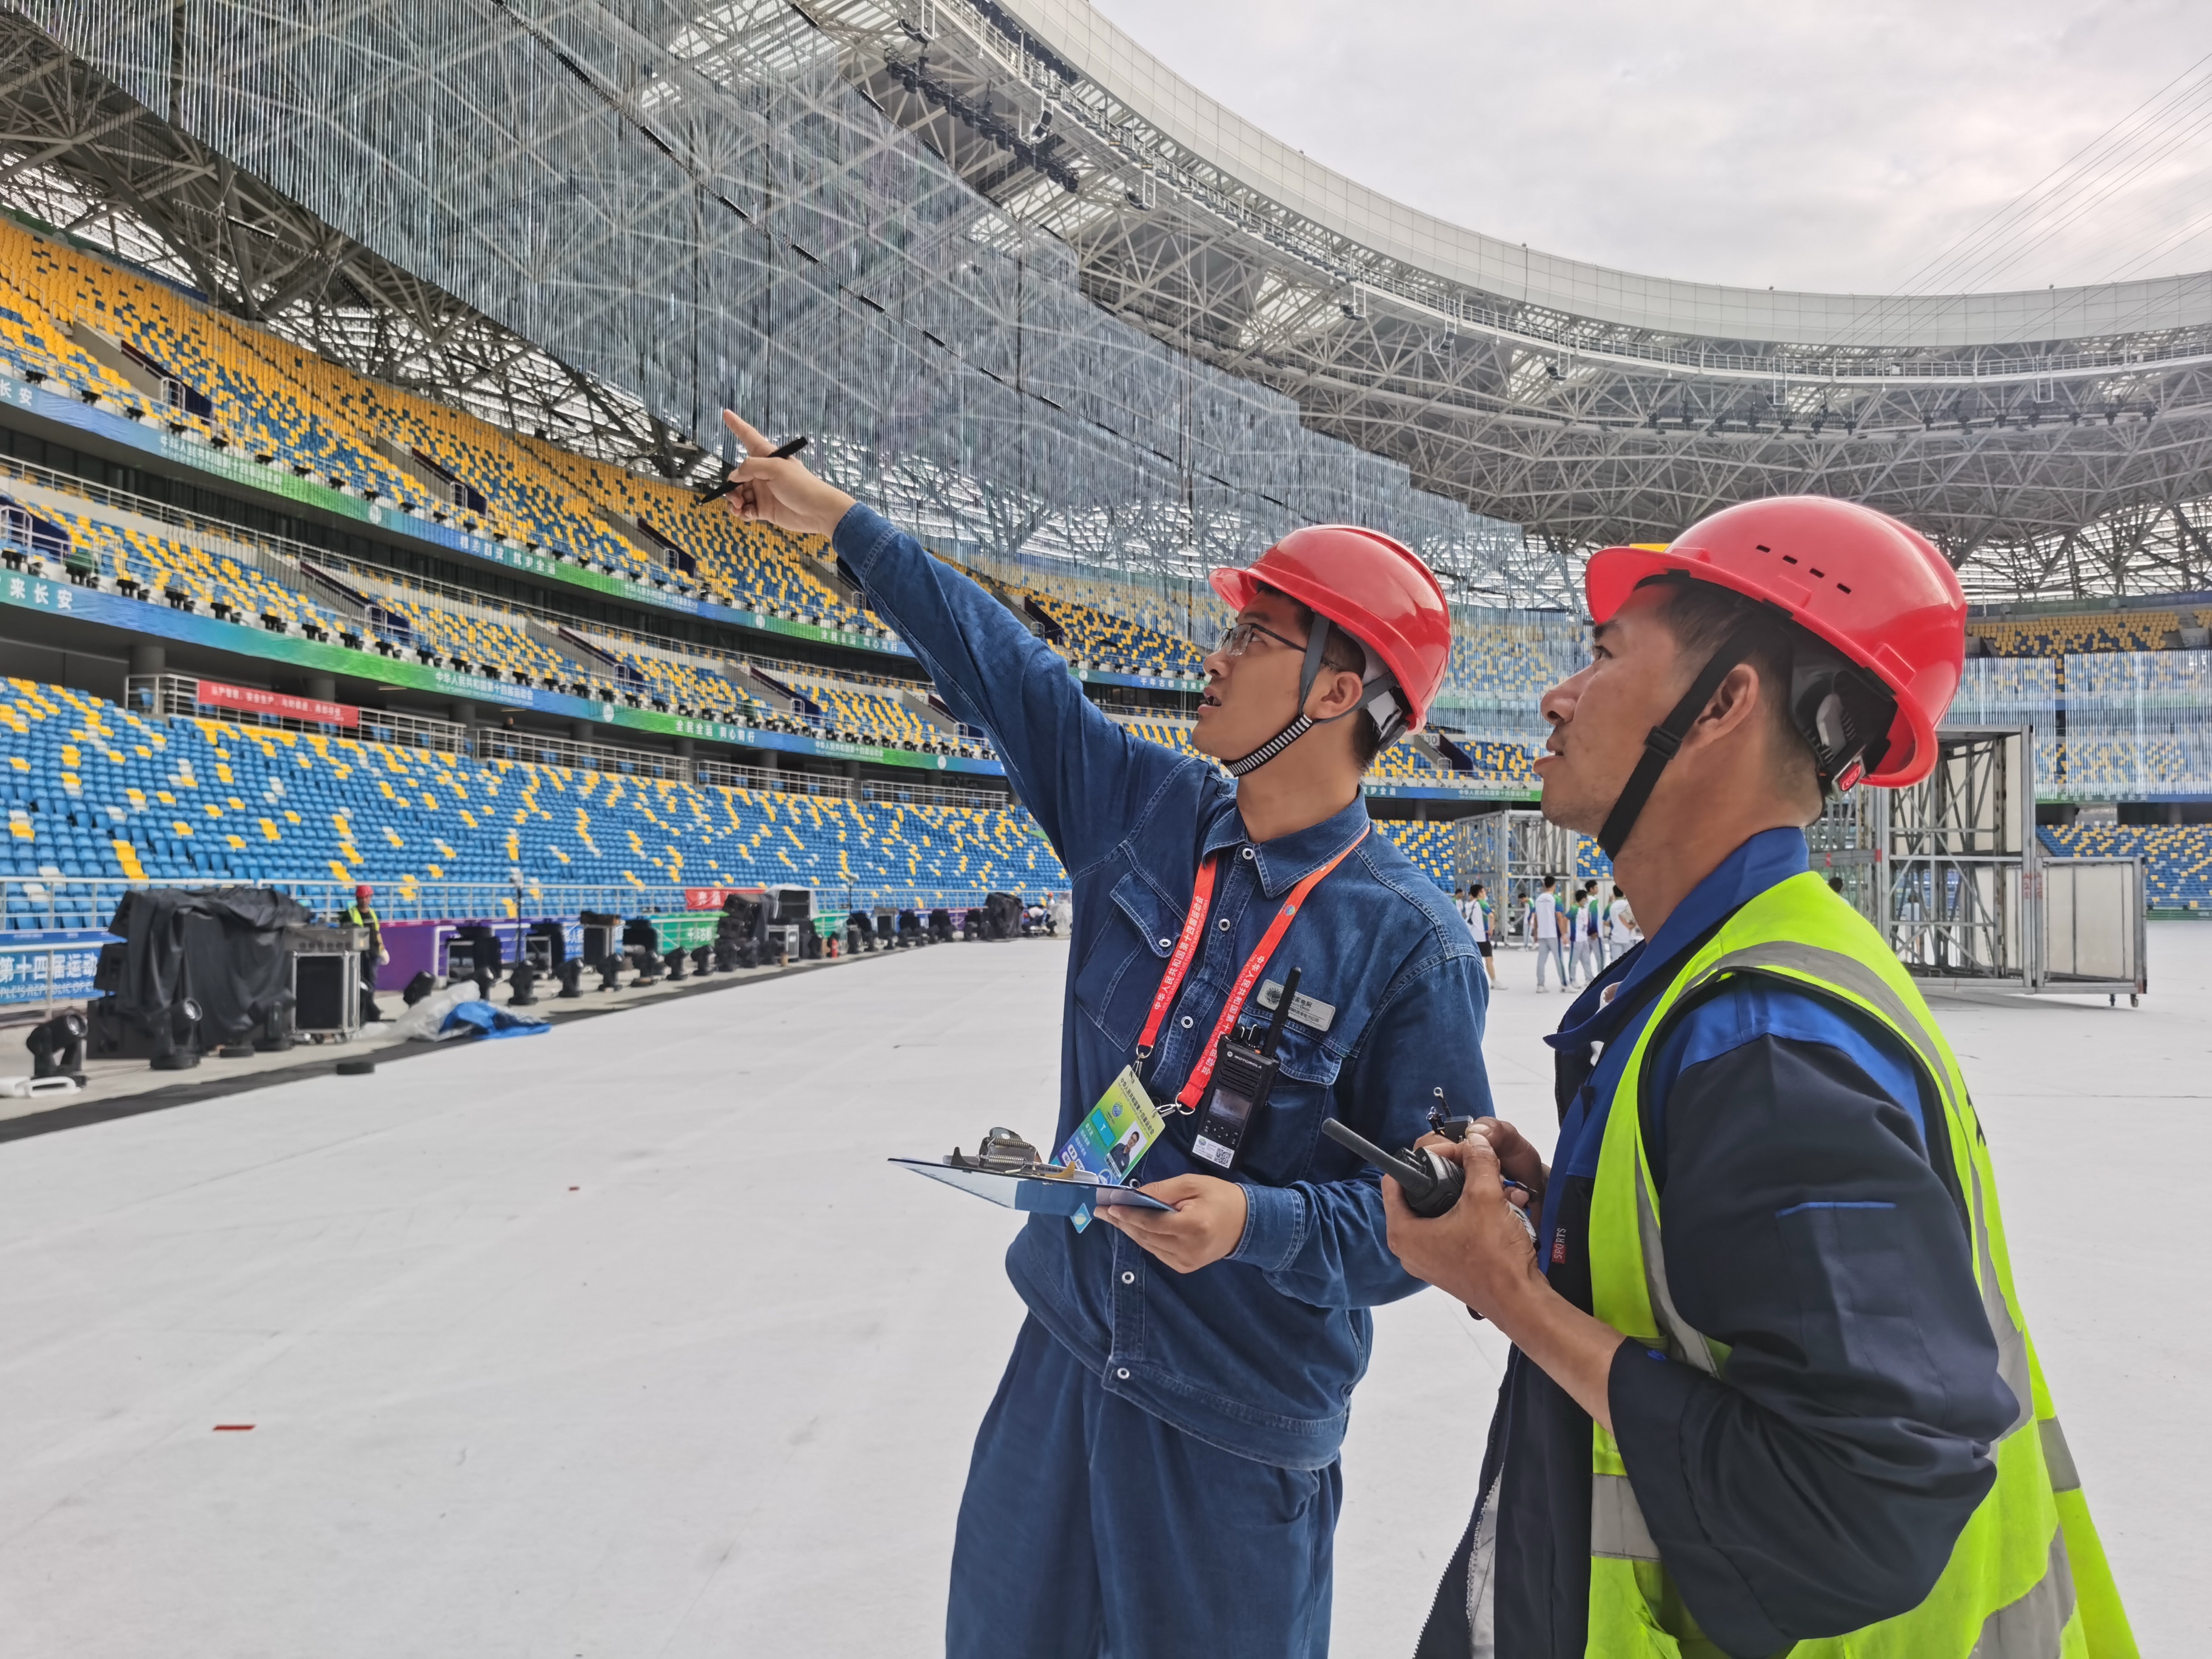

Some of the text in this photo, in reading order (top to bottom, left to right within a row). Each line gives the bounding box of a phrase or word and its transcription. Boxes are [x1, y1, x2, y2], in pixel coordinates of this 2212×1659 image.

[1141, 678, 1175, 688] 千年古都
[676, 720, 755, 743] 全民全运 同心同行
[1154, 896, 1204, 1010] 中华人民共和国第十四届运动会
[1235, 1055, 1262, 1069] MOTOROLA
[1120, 1078, 1155, 1135] 中华人民共和国第十四届运动会
[1553, 1227, 1566, 1259] SPORTS
